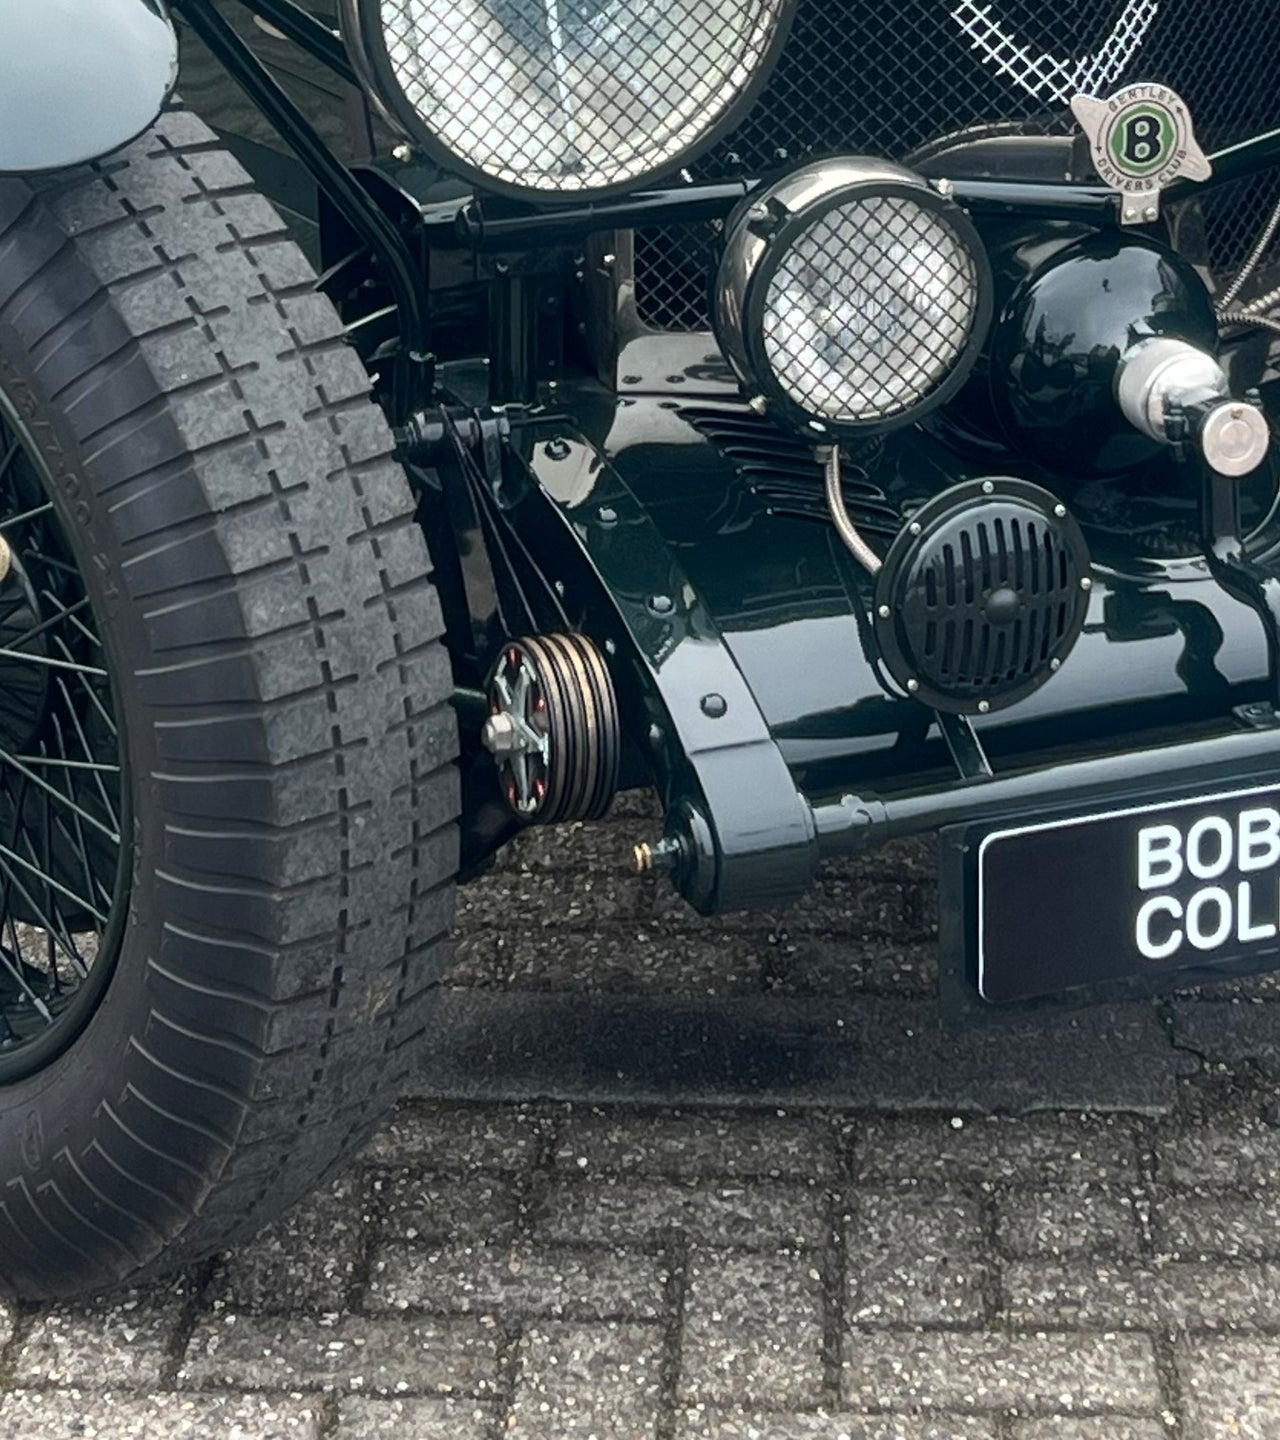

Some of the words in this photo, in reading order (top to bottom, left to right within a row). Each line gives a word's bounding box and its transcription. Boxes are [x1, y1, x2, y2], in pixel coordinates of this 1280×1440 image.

[1107, 86, 1179, 112] BENTLEY
[1123, 115, 1163, 164] B
[1097, 157, 1156, 192] DRIVERS
[1157, 149, 1188, 183] CLUB
